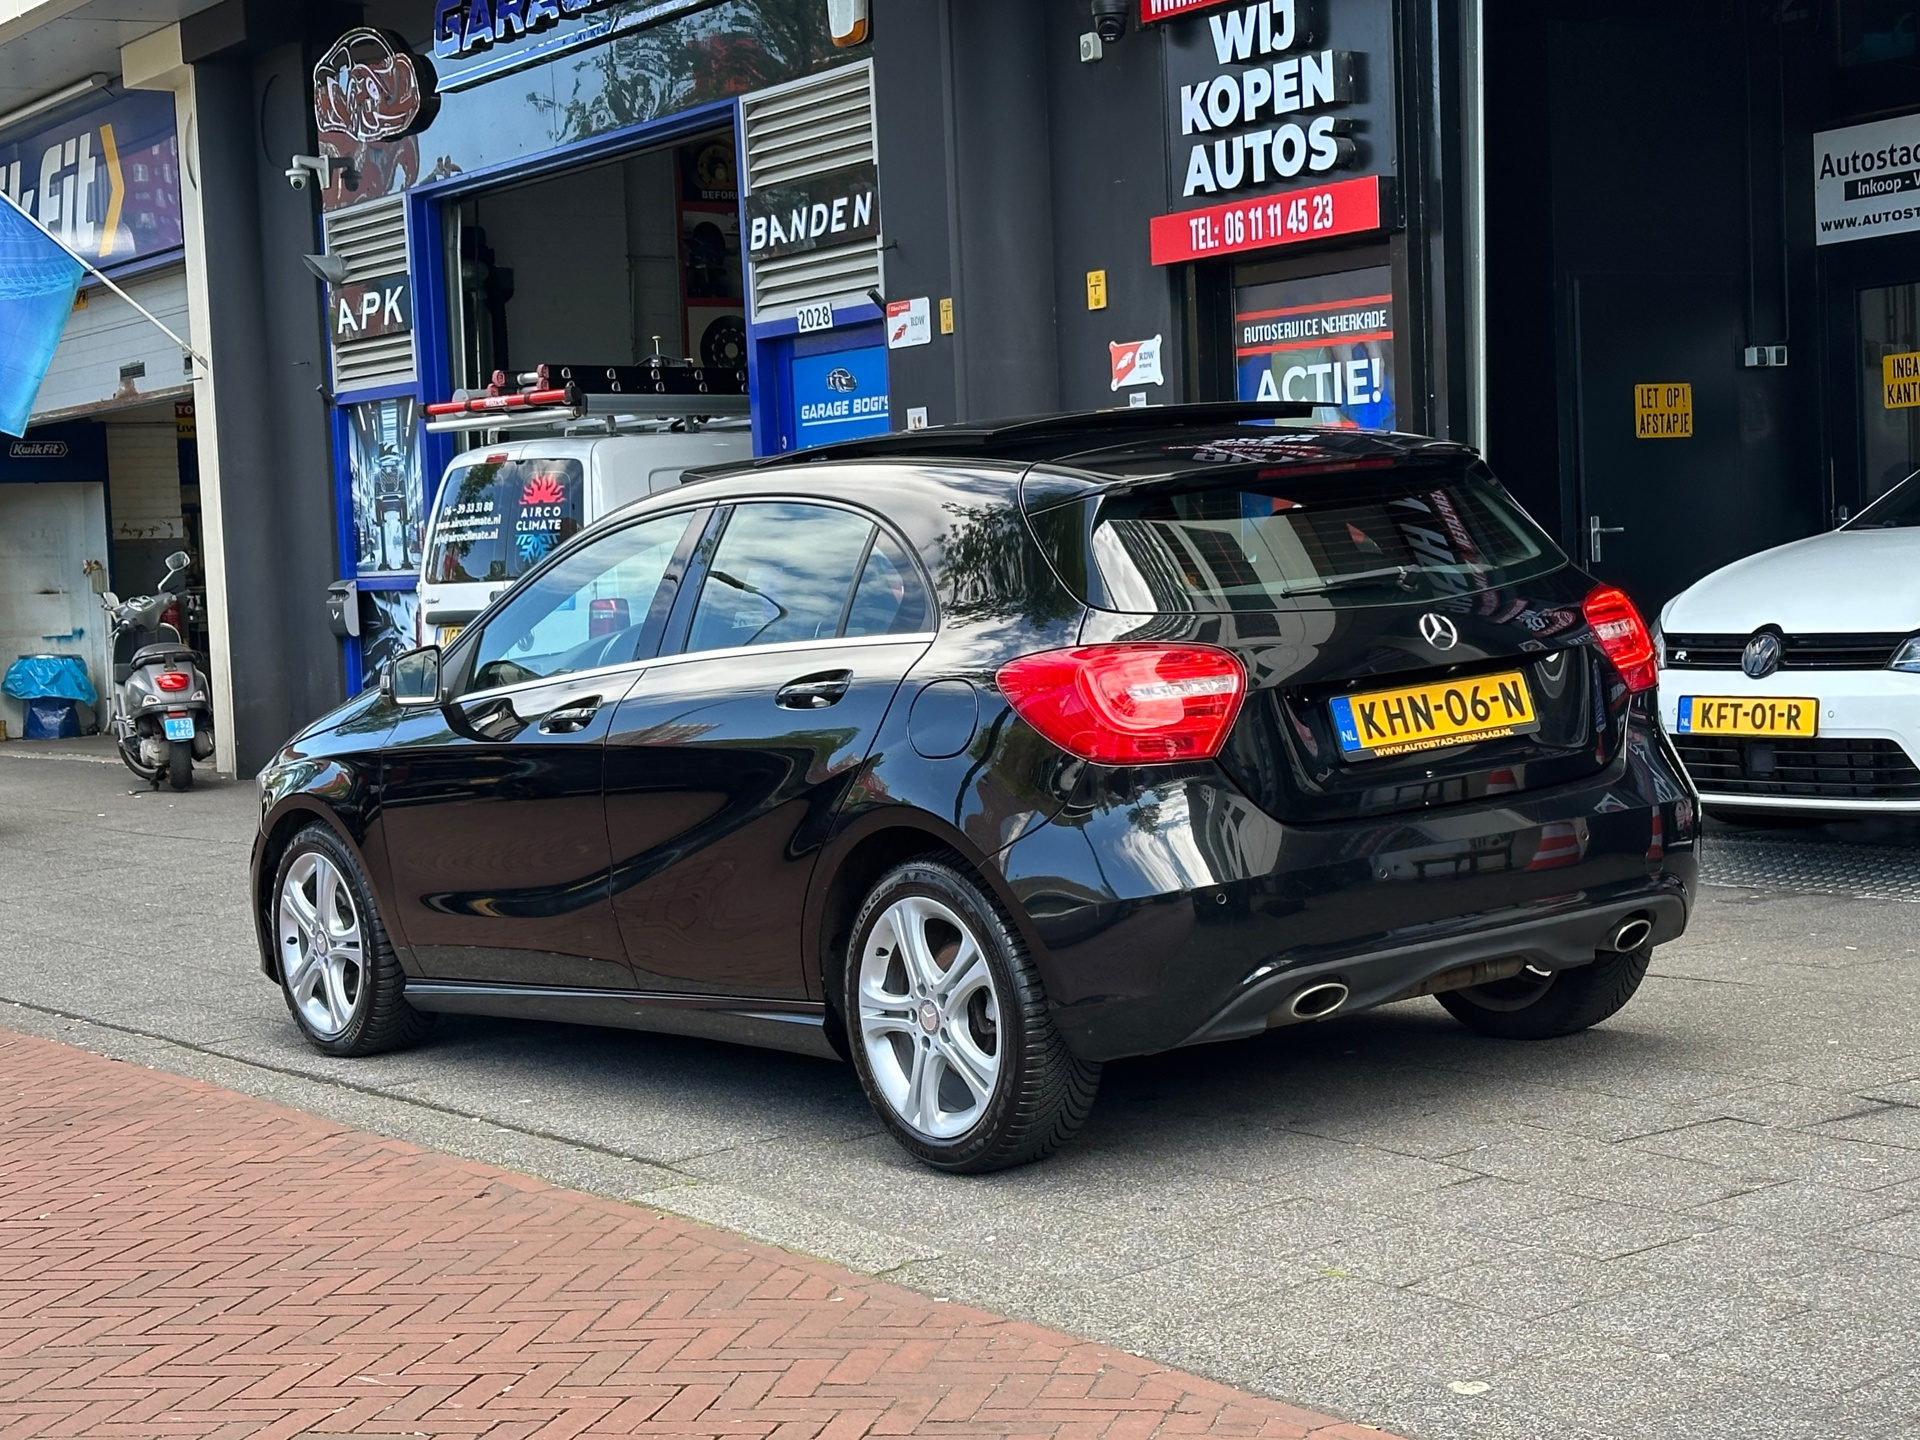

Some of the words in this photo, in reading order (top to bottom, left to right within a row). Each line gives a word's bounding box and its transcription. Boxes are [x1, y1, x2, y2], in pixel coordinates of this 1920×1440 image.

[1208, 0, 1296, 65] WIJ
[1180, 49, 1335, 136] KOPEN
[1182, 115, 1338, 197] AUTOS
[701, 189, 738, 200] BEFOR
[1858, 178, 1902, 196] Inkoop
[750, 191, 873, 251] BANDEN
[1189, 214, 1220, 251] TEL:
[1224, 209, 1245, 246] 06
[1248, 206, 1263, 241] 11
[1267, 202, 1282, 238] 11
[1286, 198, 1308, 234] 45
[1312, 193, 1333, 231] 23
[337, 285, 404, 335] APK
[798, 307, 831, 330] 2028
[1243, 318, 1319, 344] AUTOSERVICE
[1321, 309, 1387, 336] NEHERKADE
[1256, 357, 1382, 405] ACTIE!
[1887, 381, 1920, 405] KANT
[801, 400, 849, 420] GARAGE
[1640, 387, 1659, 409] LET
[1666, 387, 1686, 408] OP!
[1639, 412, 1690, 434] AFSTAPJE
[515, 519, 562, 531] CLIMATE
[521, 506, 561, 518] AIRCO
[1358, 680, 1526, 740] KHN-06-N
[1701, 702, 1801, 731] KFT-01-R
[1341, 730, 1358, 743] NL
